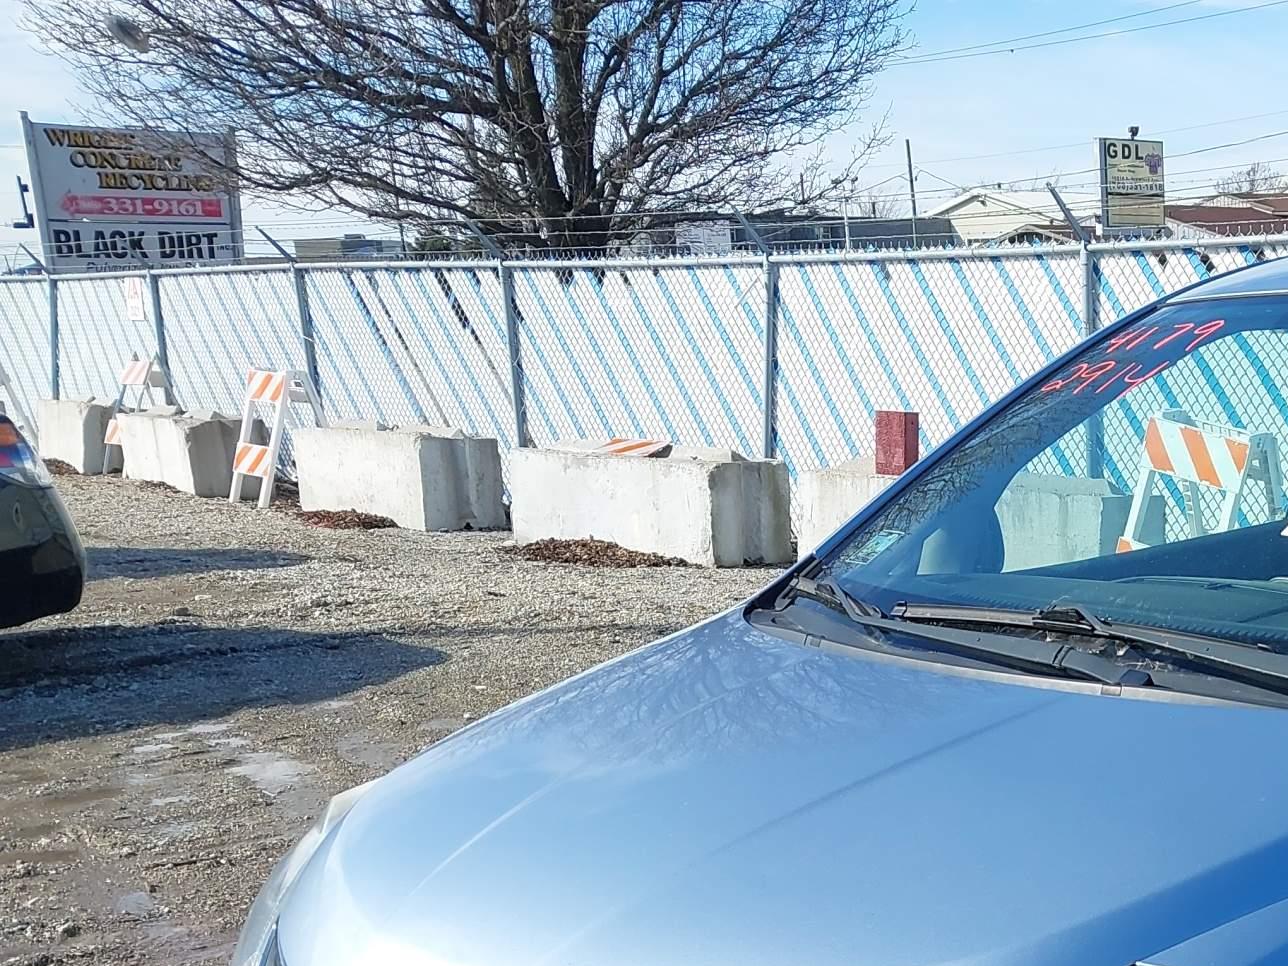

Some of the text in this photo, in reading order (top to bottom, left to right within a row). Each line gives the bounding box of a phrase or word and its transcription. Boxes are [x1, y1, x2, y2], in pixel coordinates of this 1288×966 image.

[70, 151, 182, 171] CONCRETE
[103, 198, 205, 216] 331-9161
[53, 229, 149, 259] BLACK
[158, 231, 218, 259] DIRT
[1041, 361, 1170, 398] 2914
